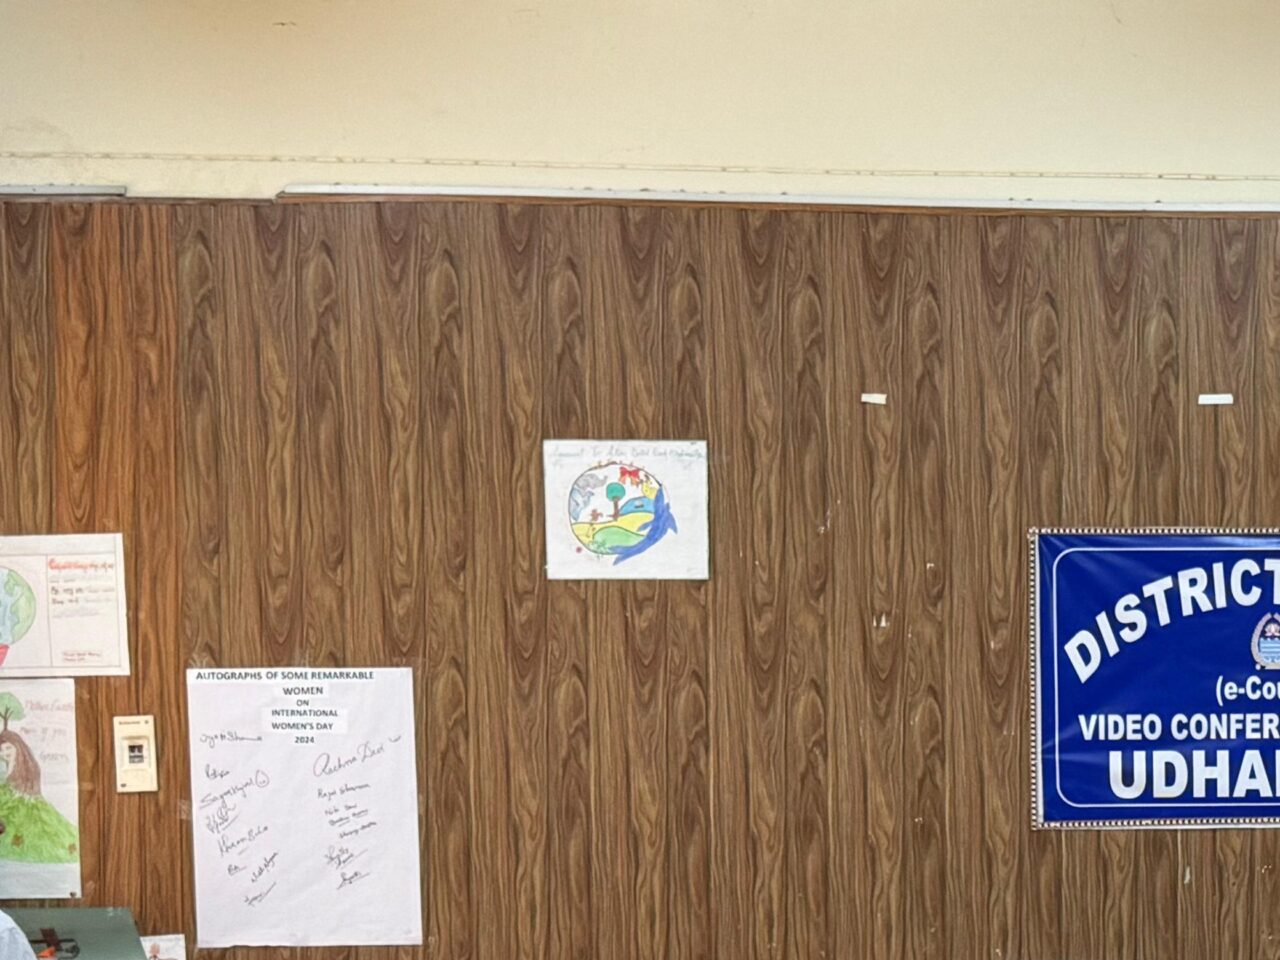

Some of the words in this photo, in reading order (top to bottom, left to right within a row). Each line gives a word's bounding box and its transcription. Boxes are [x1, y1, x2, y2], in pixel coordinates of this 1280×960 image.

[195, 671, 263, 681] AUTOGRAPHS
[266, 671, 279, 681] OF
[281, 671, 309, 681] SOME
[311, 671, 375, 681] REMARKABLE
[282, 686, 324, 696] WOMEN
[296, 699, 310, 707] ON
[271, 709, 339, 718] INTERNATIONAL
[271, 722, 314, 731] WOMEN'S
[315, 722, 334, 731] DAY
[1078, 713, 1163, 741] VIDEO
[294, 736, 315, 744] 2024
